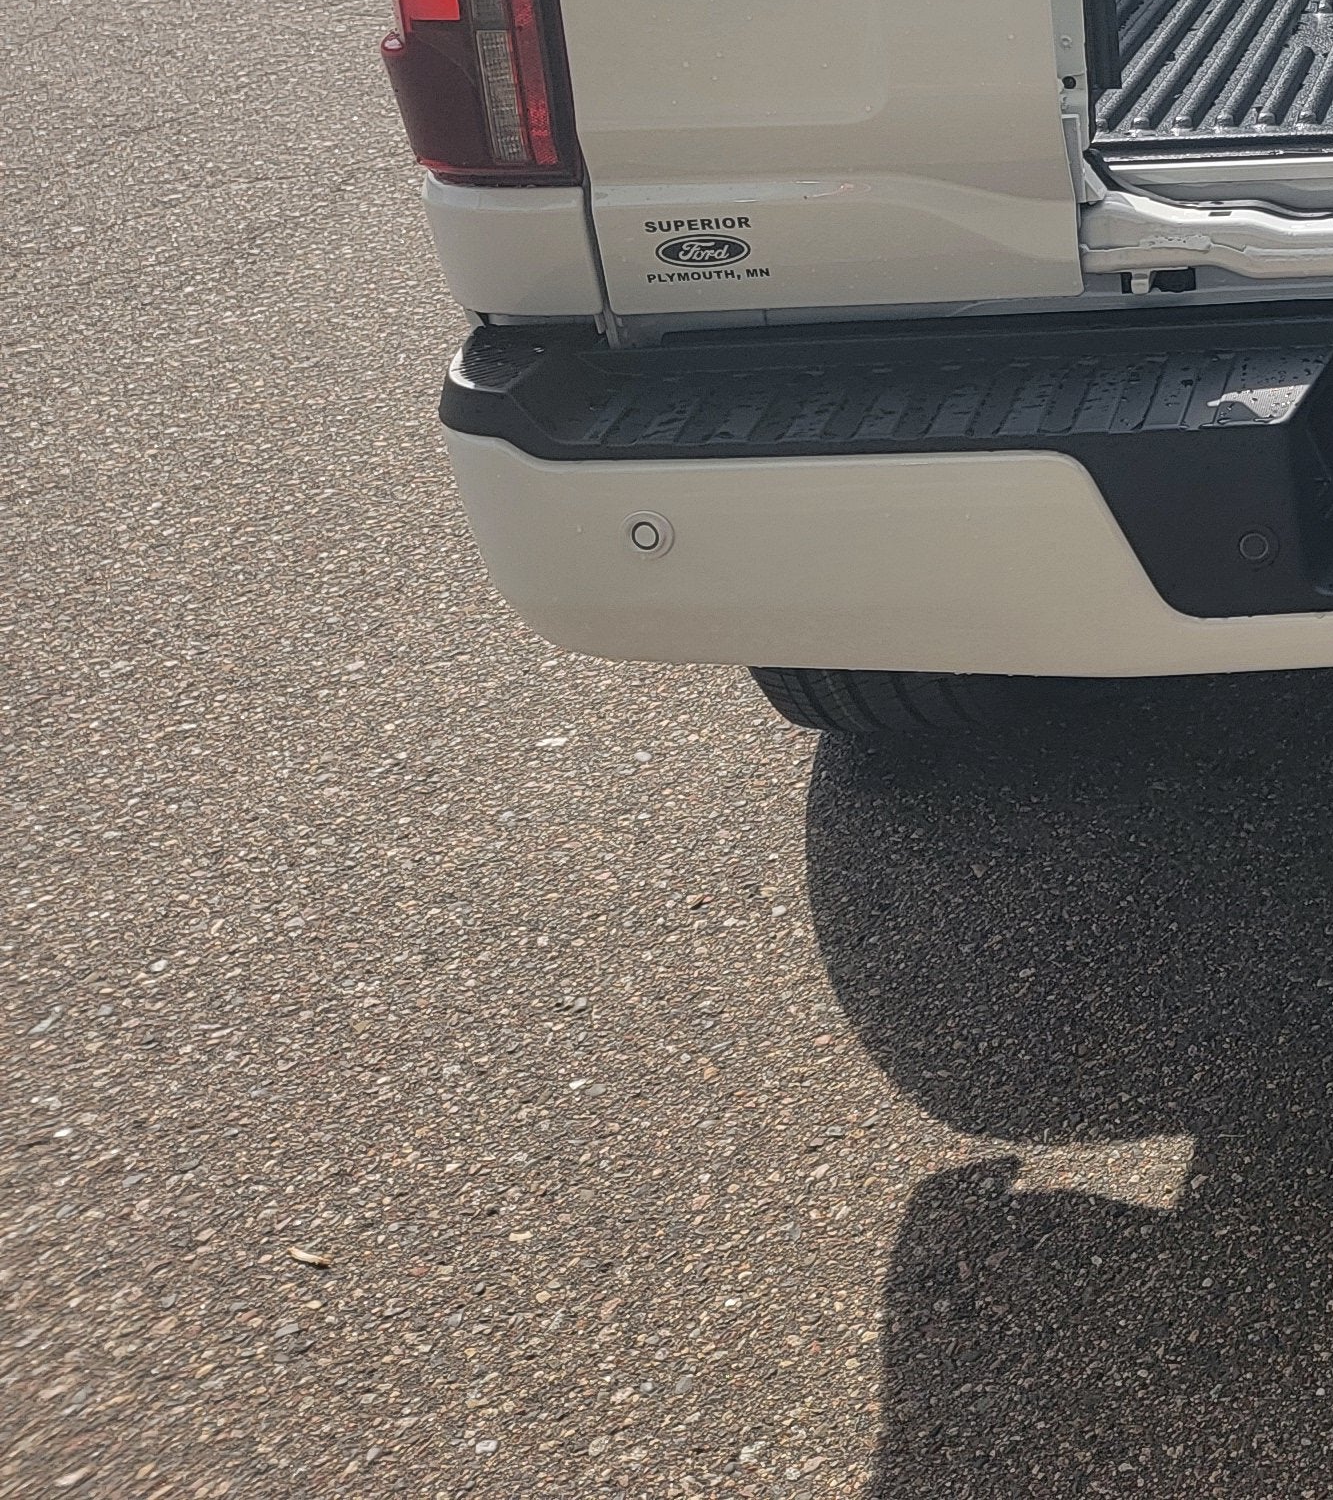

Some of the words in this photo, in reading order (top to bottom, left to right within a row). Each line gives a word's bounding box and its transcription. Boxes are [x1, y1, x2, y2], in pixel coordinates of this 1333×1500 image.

[644, 217, 752, 233] SUPERIOR
[678, 241, 730, 260] Ford
[647, 269, 742, 283] PLYMOUTH,
[746, 268, 770, 277] MN
